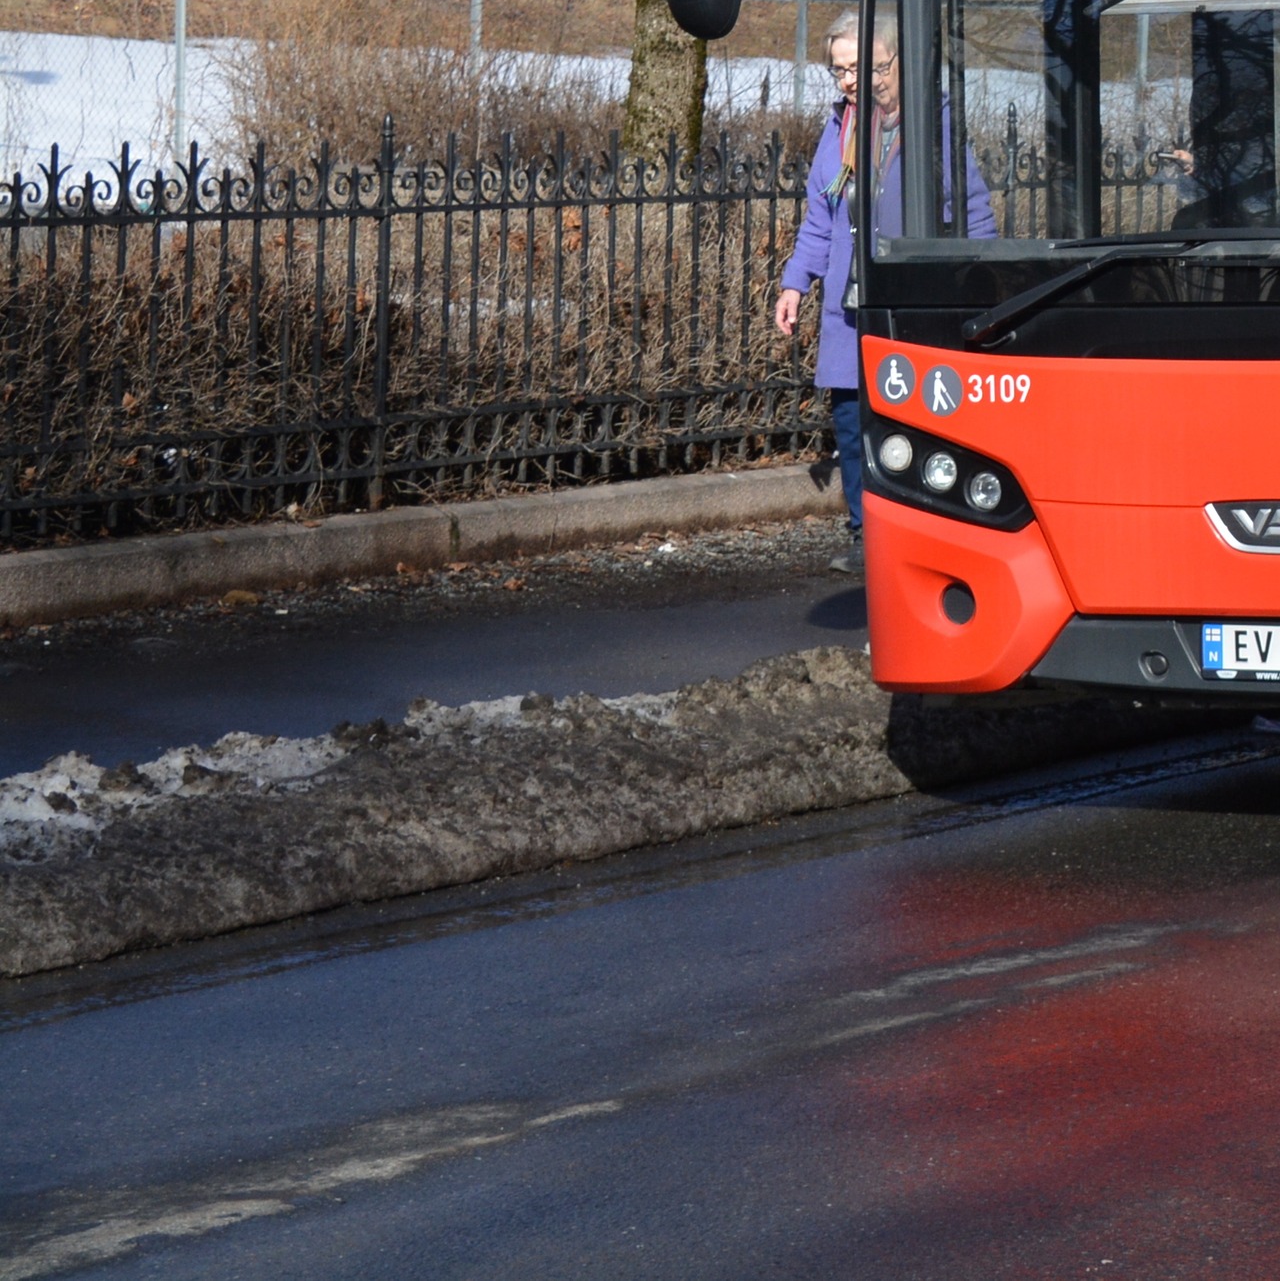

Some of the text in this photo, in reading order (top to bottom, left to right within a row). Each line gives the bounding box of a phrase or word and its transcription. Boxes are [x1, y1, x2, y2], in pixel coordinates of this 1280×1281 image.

[967, 374, 1031, 403] 3109
[1208, 651, 1219, 663] N
[1234, 630, 1273, 664] EV
